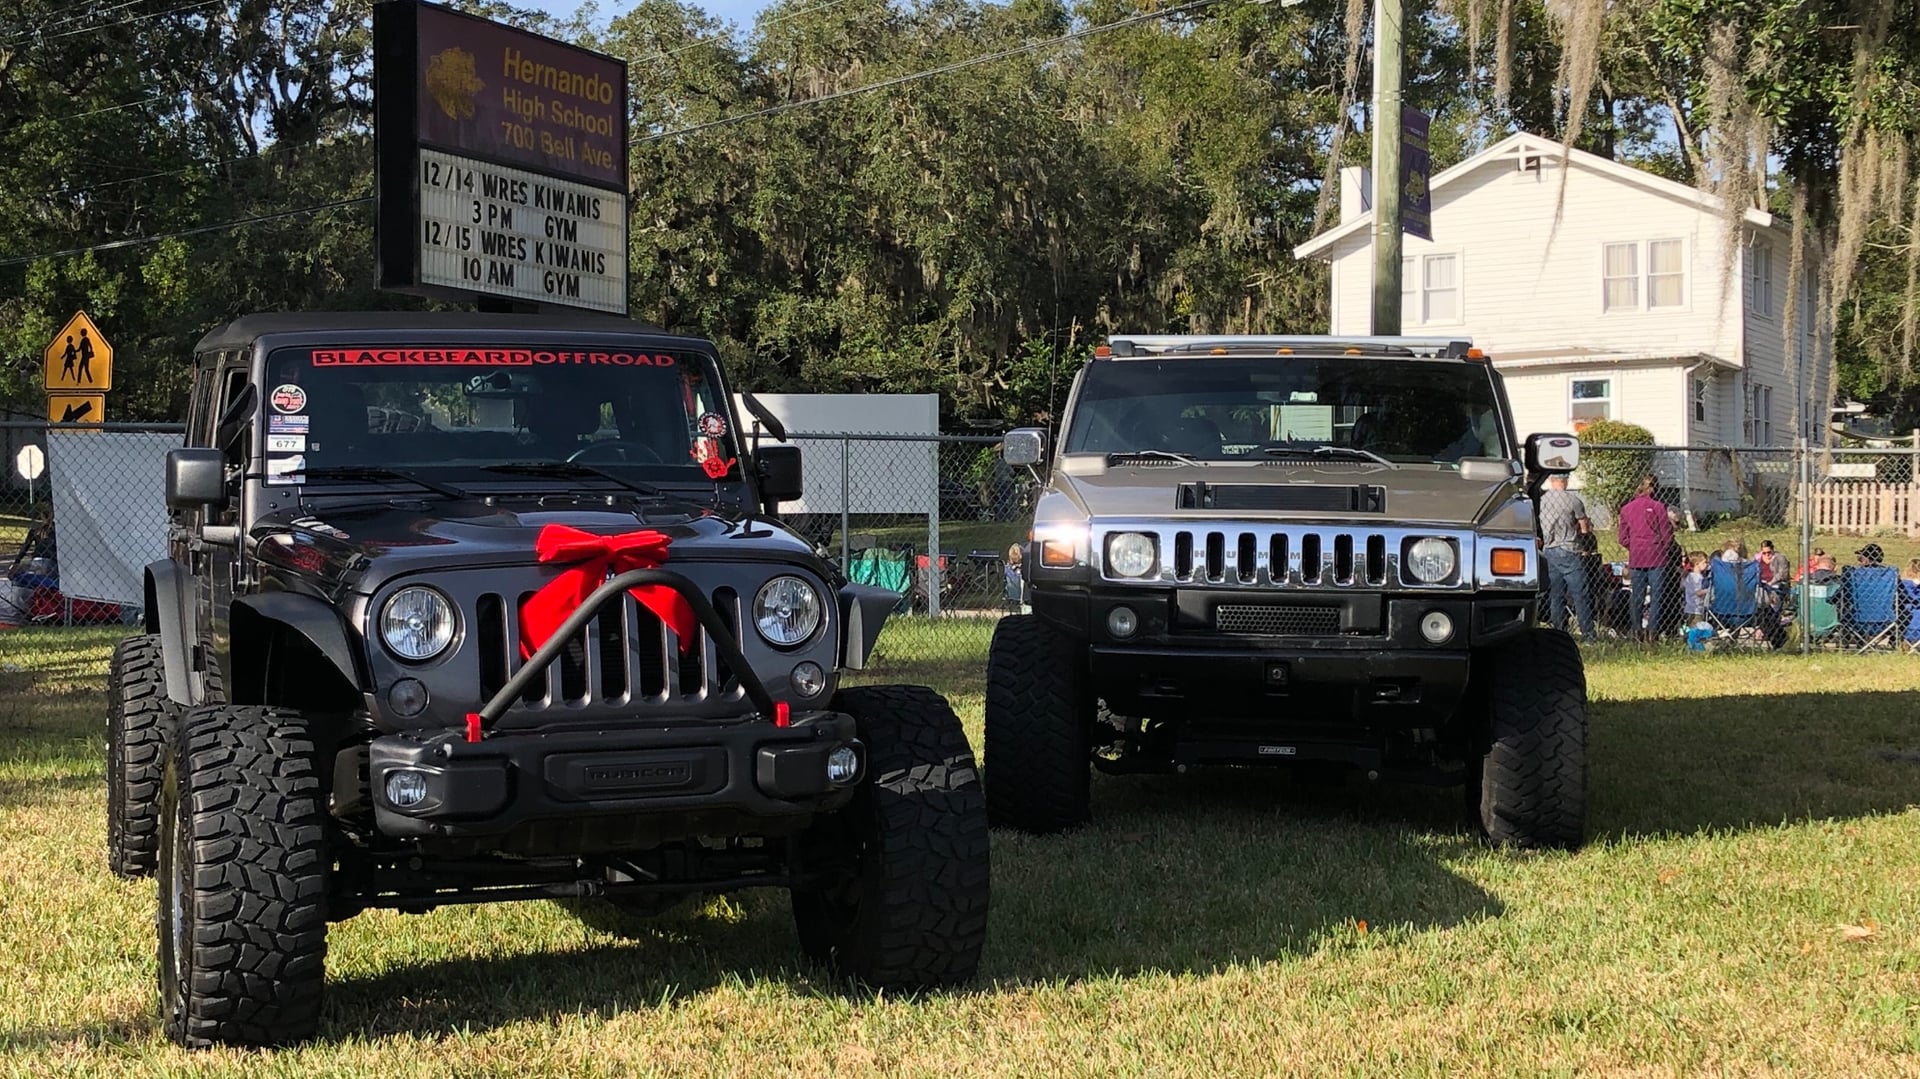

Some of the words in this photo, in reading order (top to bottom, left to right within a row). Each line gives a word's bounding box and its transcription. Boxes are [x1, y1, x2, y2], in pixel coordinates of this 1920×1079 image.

[503, 47, 613, 105] Hernando
[503, 86, 545, 124] High
[551, 100, 613, 137] School
[501, 121, 534, 151] 700
[541, 130, 574, 160] Bell
[582, 141, 617, 171] Ave.
[424, 161, 475, 193] 12/14
[482, 173, 528, 205] WRES
[535, 184, 600, 220] KIWANIS
[472, 200, 482, 224] 3
[488, 204, 512, 230] PM
[545, 215, 578, 243] GYM
[425, 220, 471, 251] 12/15
[481, 230, 527, 261] WRES
[535, 241, 605, 275] KIWANIS
[463, 257, 482, 281] 10
[488, 261, 514, 287] AM
[544, 270, 580, 298] GYM
[276, 440, 297, 448] 677
